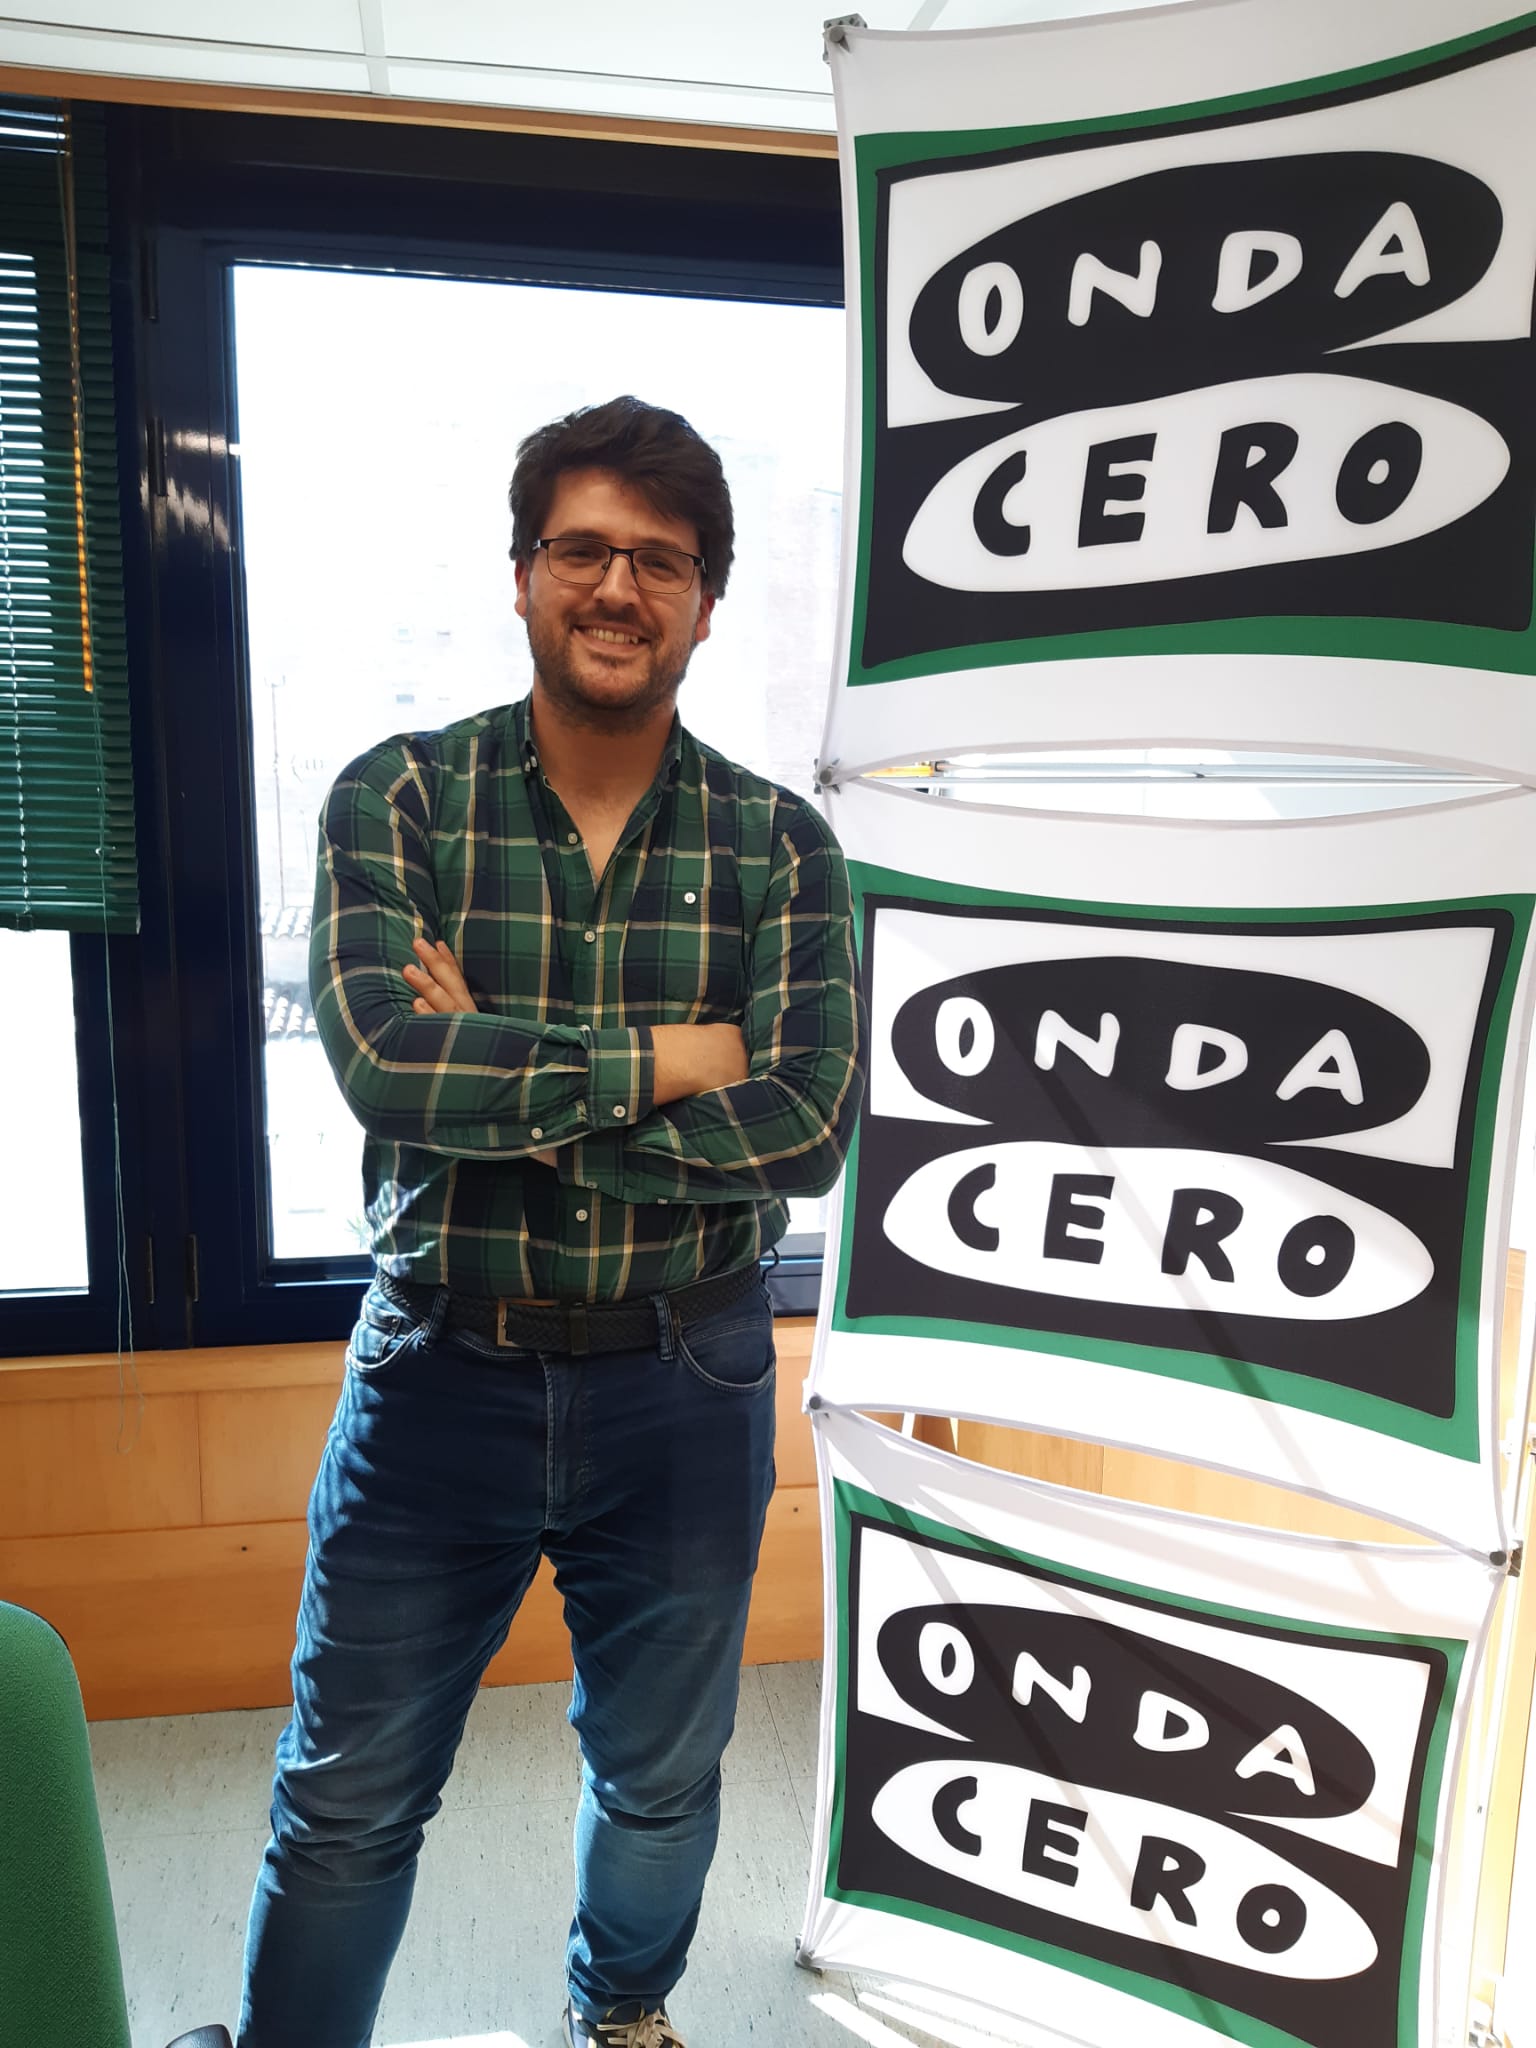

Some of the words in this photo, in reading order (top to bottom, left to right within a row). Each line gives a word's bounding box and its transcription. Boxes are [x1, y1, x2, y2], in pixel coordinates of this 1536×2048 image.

[958, 201, 1431, 357] ONDA
[973, 421, 1423, 557] CERO
[934, 996, 1364, 1106] ONDA
[947, 1163, 1356, 1298] CERO
[918, 1621, 1316, 1796] ONDA
[932, 1775, 1307, 1954] CERO
